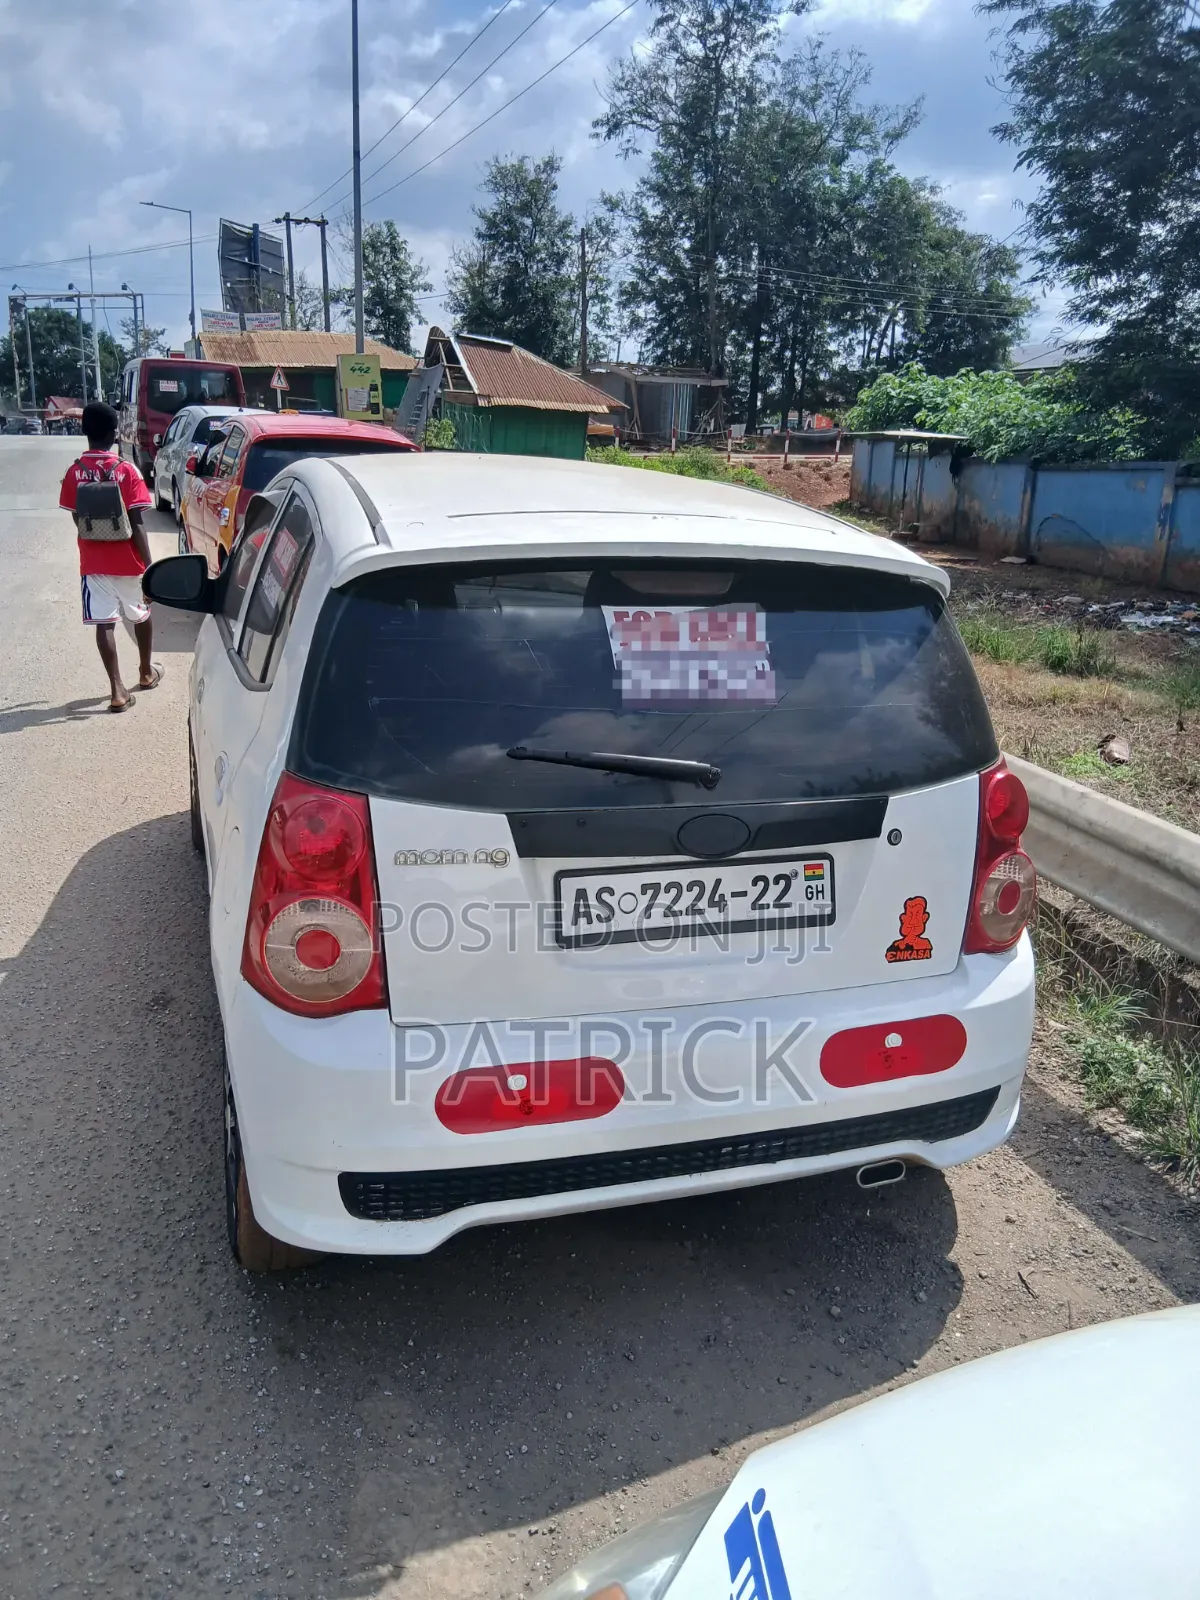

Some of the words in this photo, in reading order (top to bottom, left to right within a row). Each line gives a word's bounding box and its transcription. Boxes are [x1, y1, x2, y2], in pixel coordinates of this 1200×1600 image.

[349, 366, 371, 374] 442
[571, 886, 616, 926] AS
[640, 873, 793, 919] 7224-22
[805, 884, 825, 900] GH
